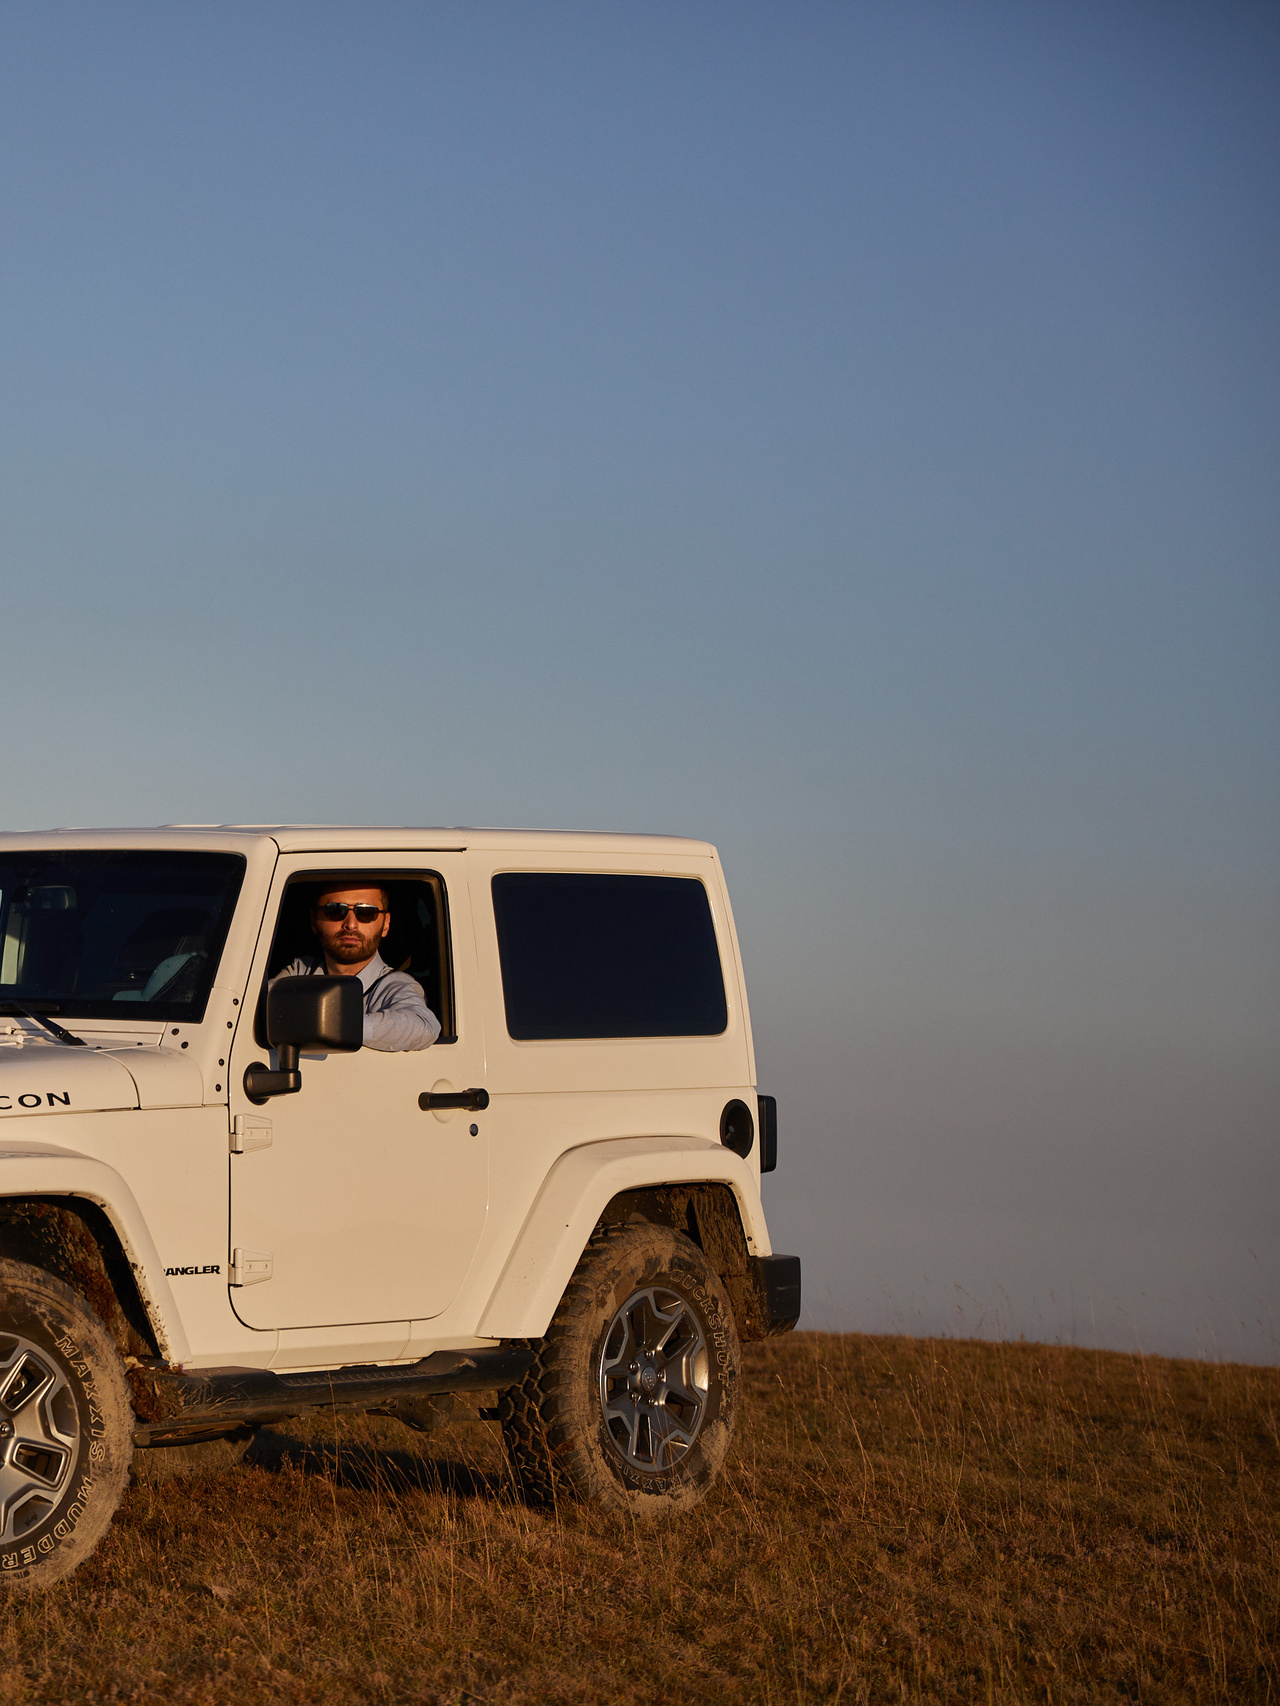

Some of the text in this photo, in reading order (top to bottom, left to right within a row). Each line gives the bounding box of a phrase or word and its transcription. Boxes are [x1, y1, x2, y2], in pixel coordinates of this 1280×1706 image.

[164, 1265, 221, 1276] ANGLER
[1, 1335, 107, 1570] MAXXIS MUDDER
